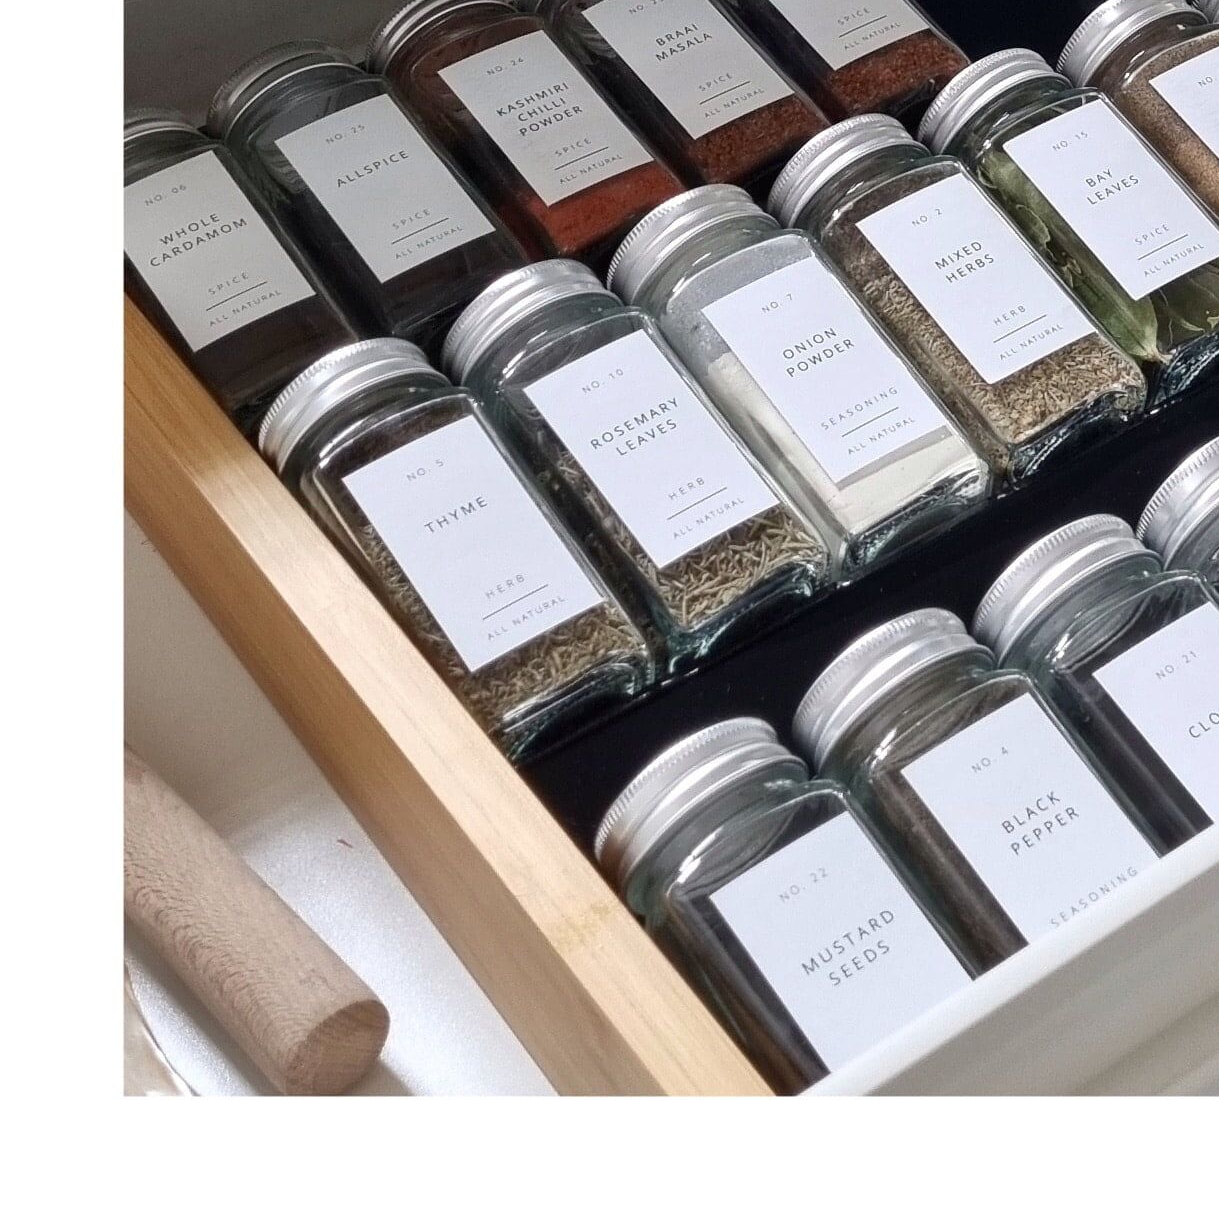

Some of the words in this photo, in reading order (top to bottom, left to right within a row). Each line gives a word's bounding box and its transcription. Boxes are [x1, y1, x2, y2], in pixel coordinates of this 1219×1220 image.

[837, 6, 871, 26] SPICE
[655, 32, 713, 62] MASALA
[656, 23, 699, 47] BRAAI
[844, 41, 859, 51] ALL
[861, 22, 901, 42] NATURAL
[699, 72, 734, 92] SPICE
[496, 82, 569, 117] KASHMIRI
[518, 97, 566, 122] CHILLI
[704, 108, 721, 119] ALL
[723, 88, 765, 108] NATURAL
[519, 105, 583, 137] POWDER
[555, 137, 592, 157] SPICE
[336, 150, 409, 188] ALLSPICE
[559, 174, 577, 185] ALL
[580, 154, 623, 174] NATURAL
[1085, 168, 1114, 188] BAY
[1086, 174, 1140, 206] LEAVES
[392, 208, 431, 230] SPICE
[935, 207, 943, 216] 2
[150, 218, 248, 267] CARDAMOM
[160, 213, 220, 246] WHOLE
[394, 248, 413, 260] ALL
[416, 226, 463, 248] NATURAL
[1135, 223, 1170, 245] SPICE
[934, 240, 983, 271] MIXED
[945, 253, 995, 284] HERBS
[1143, 265, 1161, 277] ALL
[1162, 243, 1204, 267] NATURAL
[208, 272, 249, 295] SPICE
[786, 293, 794, 301] 7
[209, 314, 228, 328] ALL
[232, 290, 282, 315] NATURAL
[993, 304, 1026, 326] HERB
[783, 327, 838, 360] ONION
[999, 347, 1017, 361] ALL
[1019, 322, 1063, 349] NATURAL
[786, 338, 856, 378] POWDER
[608, 368, 624, 380] 10
[590, 397, 680, 450] ROSEMARY
[821, 386, 899, 430] SEASONING
[616, 418, 678, 456] LEAVES
[848, 441, 866, 455] ALL
[869, 416, 916, 442] NATURAL
[436, 458, 444, 468] 5
[668, 477, 706, 501] HERB
[424, 496, 489, 534] THYME
[673, 525, 693, 540] ALL
[696, 497, 745, 525] NATURAL
[485, 573, 526, 599] HERB
[487, 626, 508, 641] ALL
[512, 596, 566, 625] NATURAL
[1182, 650, 1197, 665] 21
[1001, 746, 1009, 756] 4
[1001, 791, 1061, 834] BLACK
[1010, 806, 1080, 856] PEPPER
[810, 867, 828, 883] 22
[1050, 866, 1139, 928] SEASONING
[801, 910, 895, 976] MUSTARD
[829, 940, 890, 986] SEEDS
